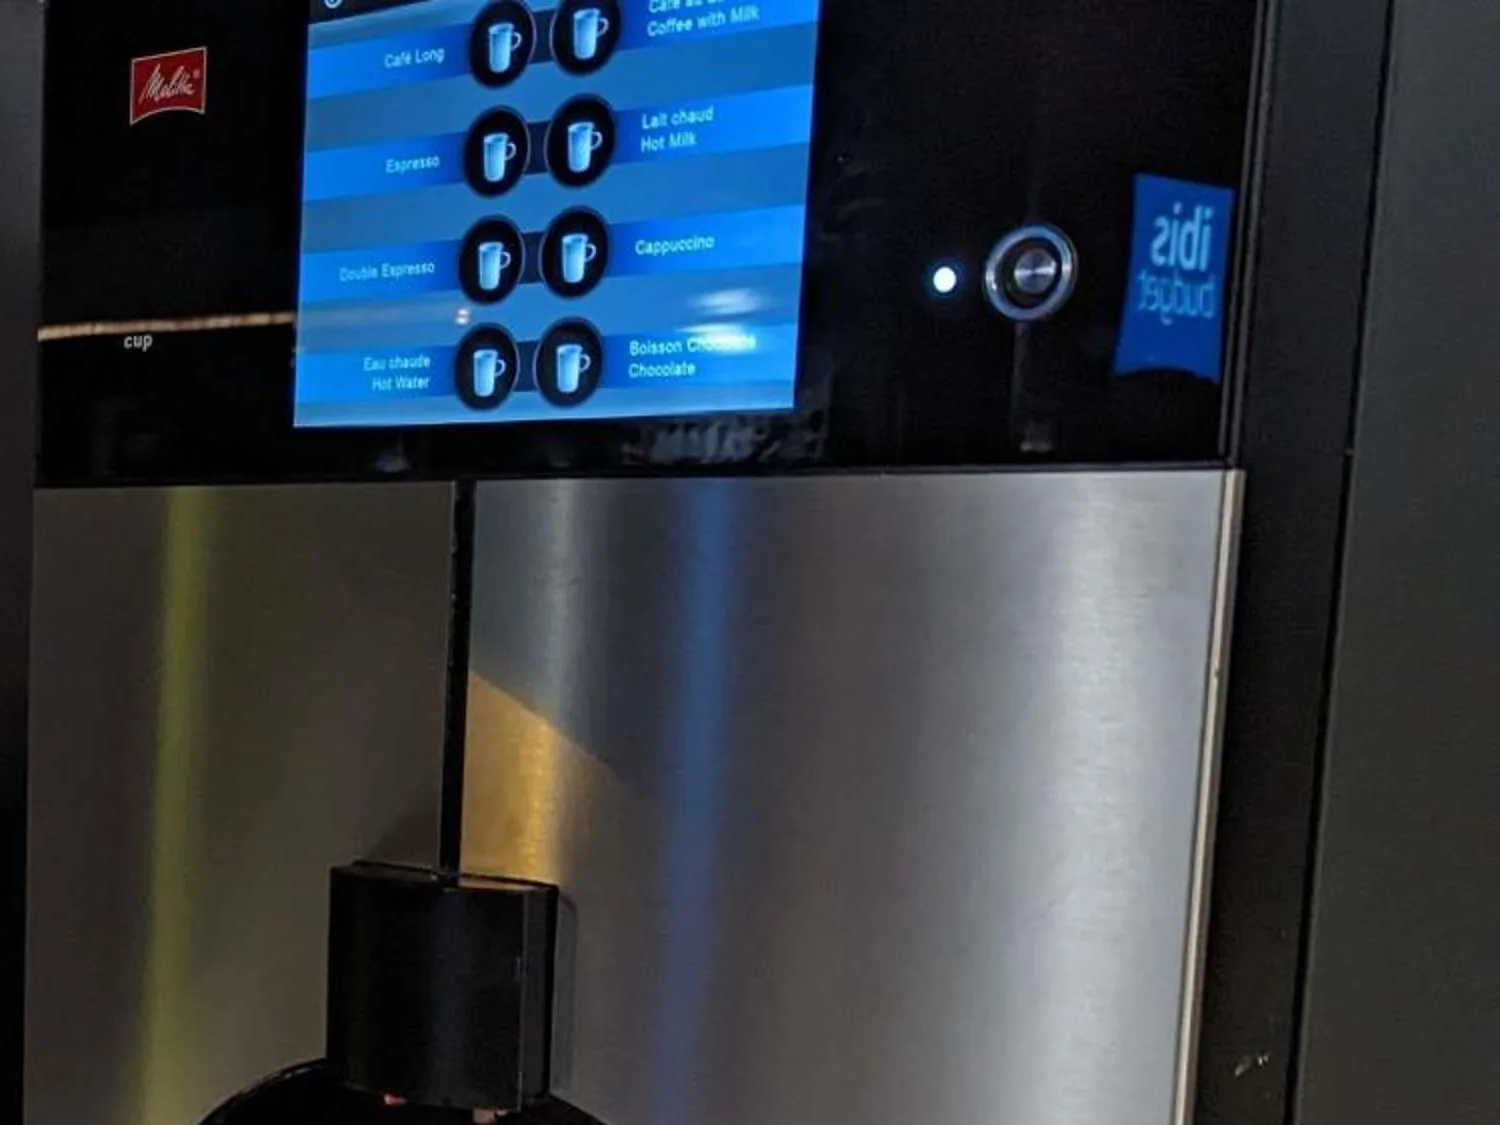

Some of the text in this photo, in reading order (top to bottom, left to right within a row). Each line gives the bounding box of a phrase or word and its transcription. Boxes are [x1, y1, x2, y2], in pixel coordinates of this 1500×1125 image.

[647, 4, 759, 37] Coffee with Milk
[415, 48, 445, 64] Long
[642, 106, 714, 129] Lait chaud
[641, 131, 697, 152] Hot Milk
[385, 155, 440, 174] Espresso
[635, 235, 715, 256] Cappuccino
[339, 260, 435, 283] Double Espresso
[124, 334, 153, 352] cup
[629, 339, 683, 357] Boisson
[628, 361, 697, 379] Chocolate
[395, 373, 430, 390] Water
